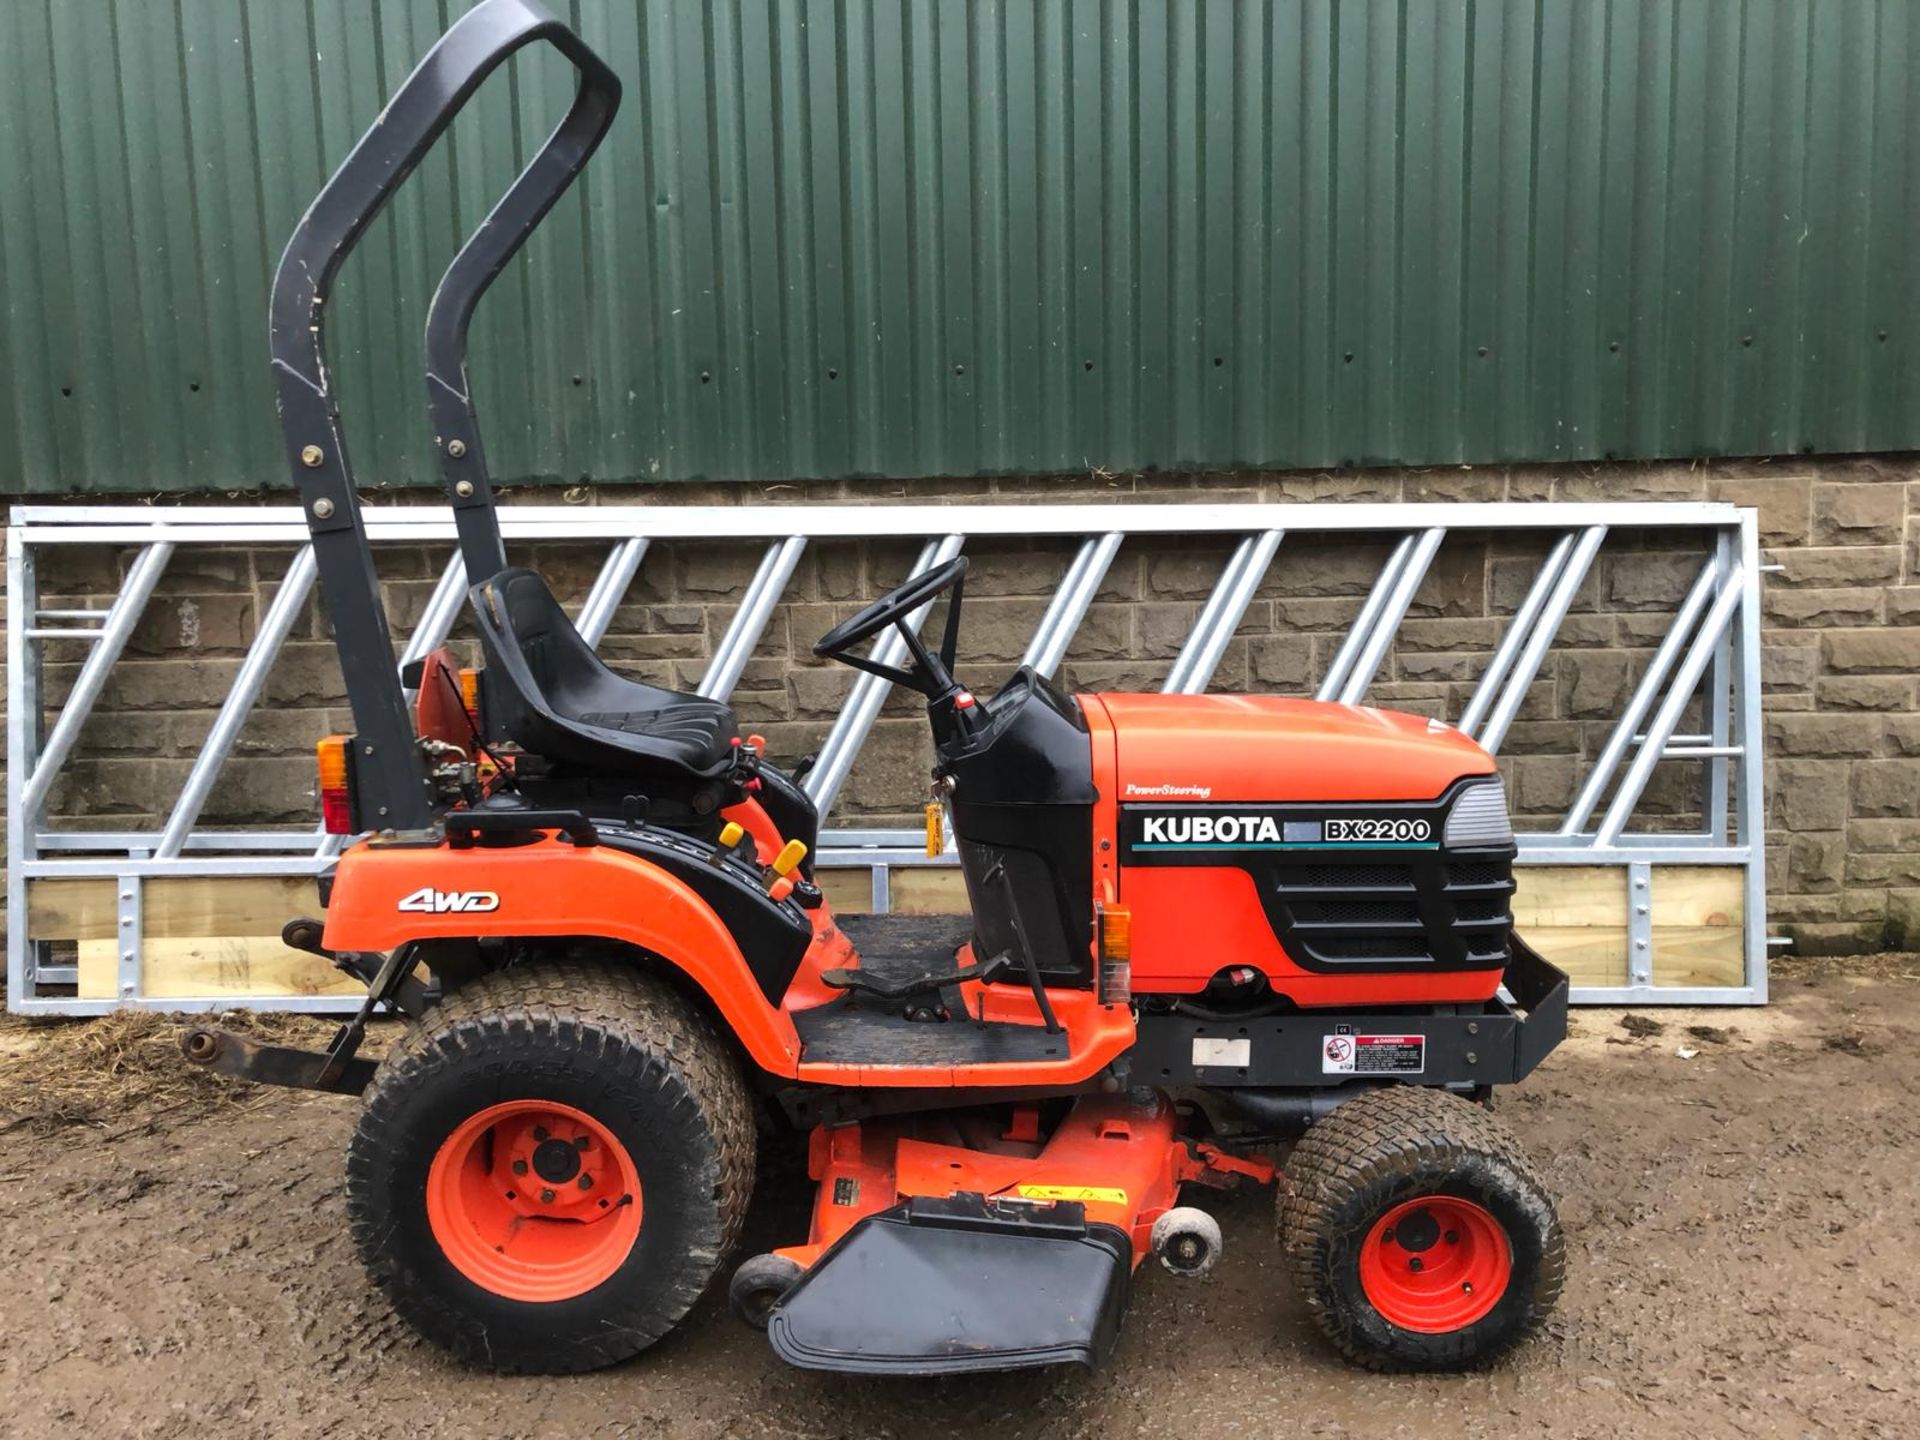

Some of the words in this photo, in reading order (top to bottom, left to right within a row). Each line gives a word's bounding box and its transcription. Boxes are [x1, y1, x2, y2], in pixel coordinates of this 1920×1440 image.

[1126, 784, 1211, 799] PowerSteering
[1143, 816, 1281, 842] KUBOTA
[1325, 819, 1431, 842] BX2200
[398, 887, 500, 914] 4WD
